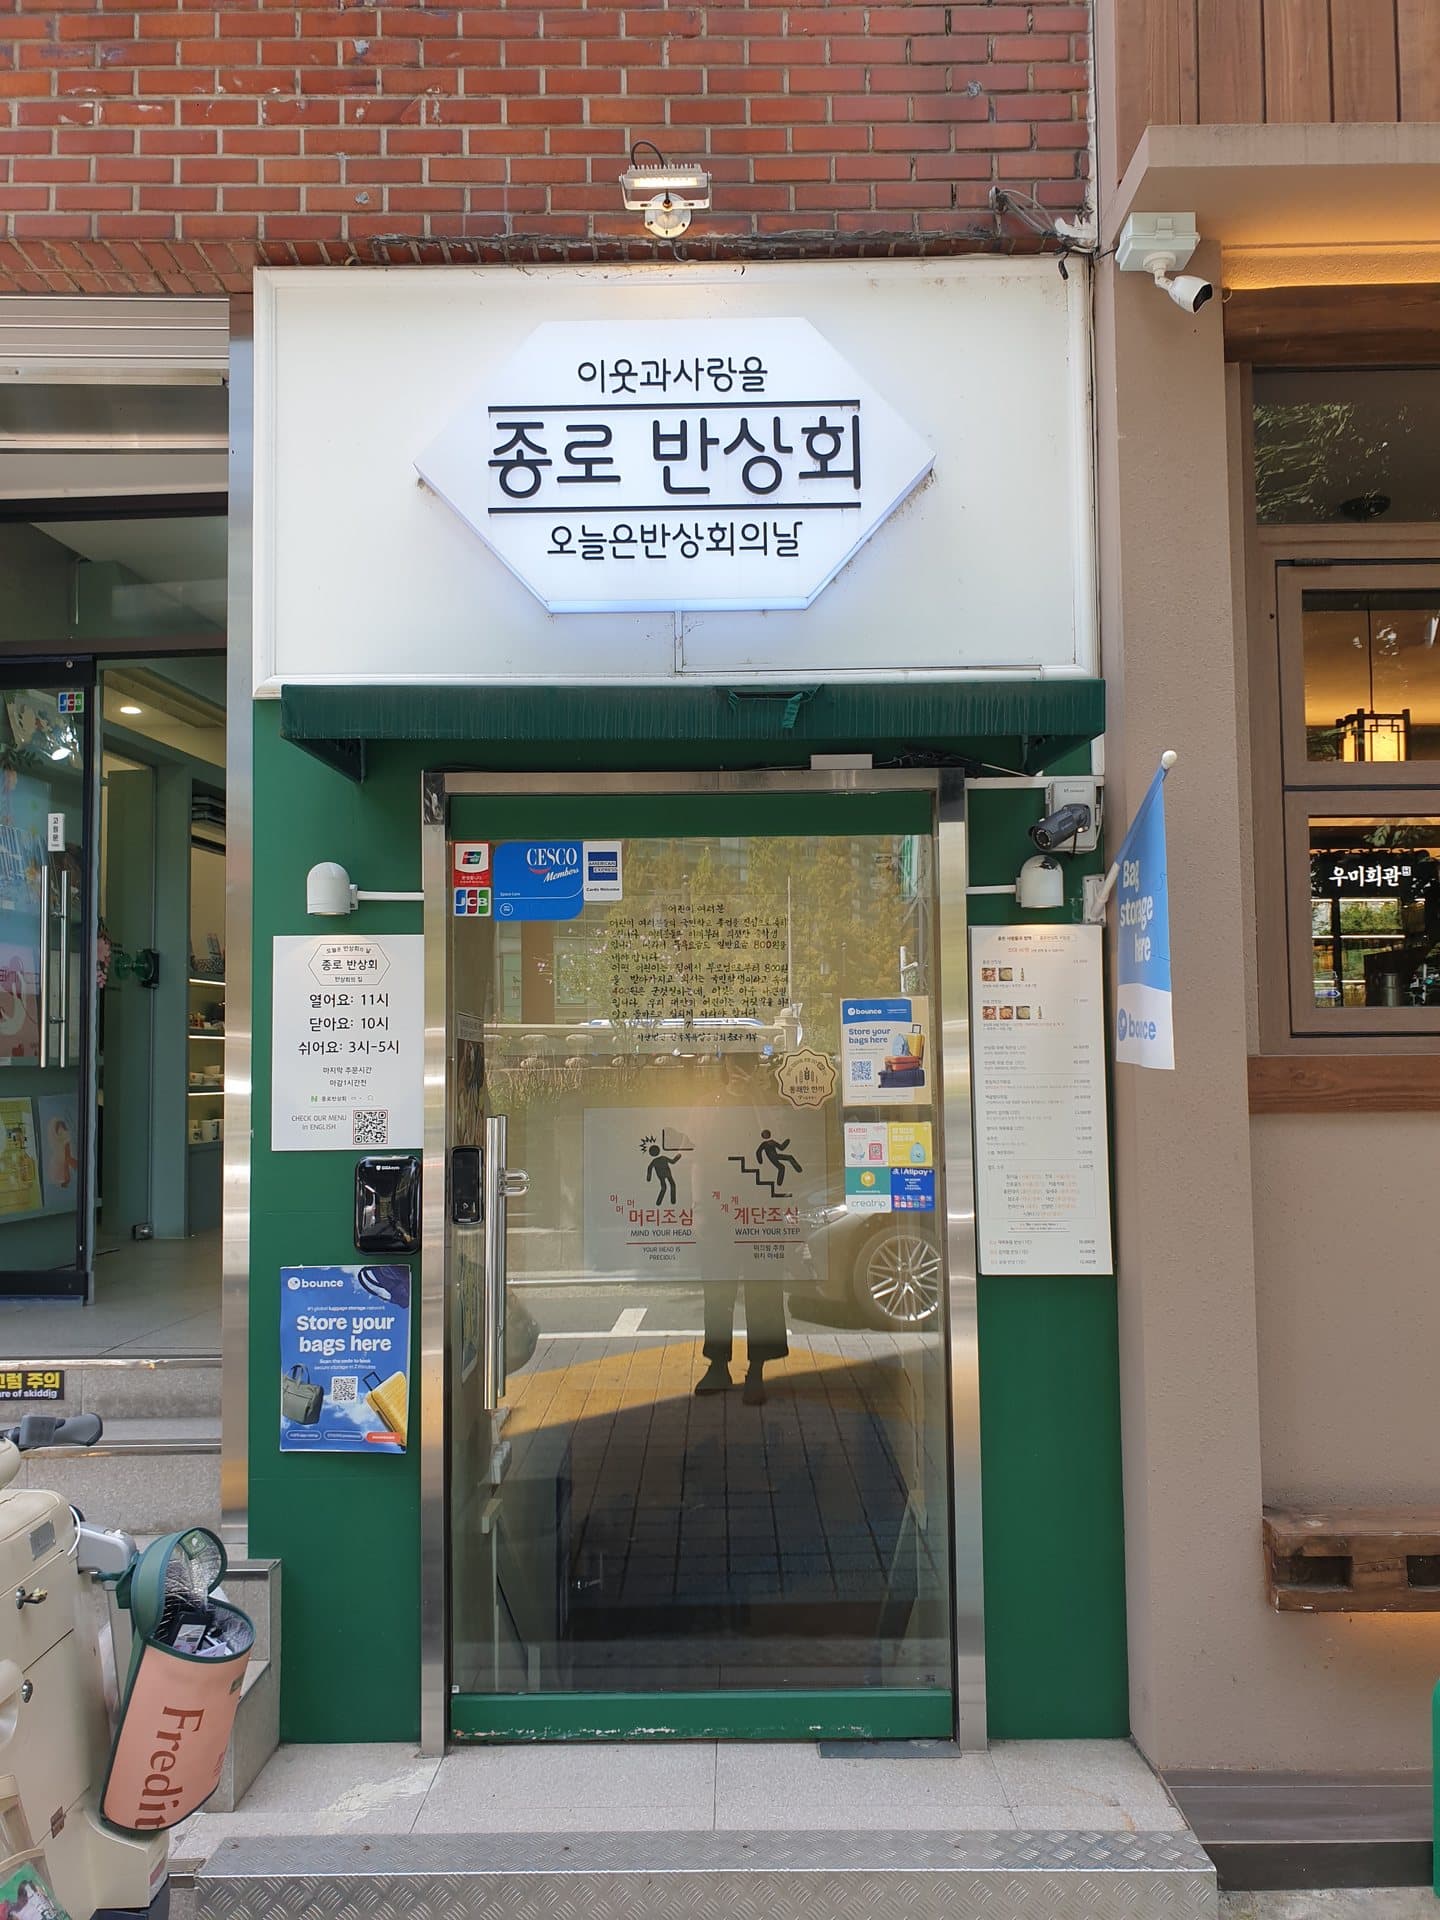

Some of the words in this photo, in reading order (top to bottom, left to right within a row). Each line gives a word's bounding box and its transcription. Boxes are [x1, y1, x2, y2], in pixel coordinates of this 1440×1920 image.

[577, 356, 768, 394] 이웃과사랑을
[487, 421, 622, 498] 종로
[652, 414, 861, 495] 반상회
[547, 520, 803, 560] 오늘은반상회의날
[527, 848, 578, 867] CESCO
[1329, 865, 1402, 888] 우미회관
[321, 958, 343, 971] 종로
[346, 958, 378, 971] 반상회
[309, 993, 354, 1008] 열어요:
[361, 992, 390, 1007] 11시
[309, 1017, 354, 1031] 닫아요:
[361, 1016, 390, 1031] 10시
[298, 1041, 343, 1056] 쉬어요:
[348, 1039, 400, 1055] 3시-5시
[848, 1036, 869, 1045] bags
[328, 1114, 347, 1122] MENU
[629, 1207, 694, 1227] 머리조심
[733, 1206, 799, 1225] 계단조심
[630, 1229, 650, 1237] MIND
[652, 1229, 671, 1237] YOUR
[672, 1229, 692, 1237] HEAD
[735, 1228, 761, 1236] WATCH
[762, 1228, 782, 1236] YOUR
[782, 1228, 801, 1236] STEP
[302, 1278, 344, 1289] bounce
[296, 1315, 348, 1331] Store
[352, 1316, 395, 1334] your
[299, 1336, 345, 1356] bags
[350, 1335, 392, 1352] here
[27, 1371, 60, 1389] 주의
[12, 1389, 22, 1398] of
[134, 1705, 205, 1830] Fredit
